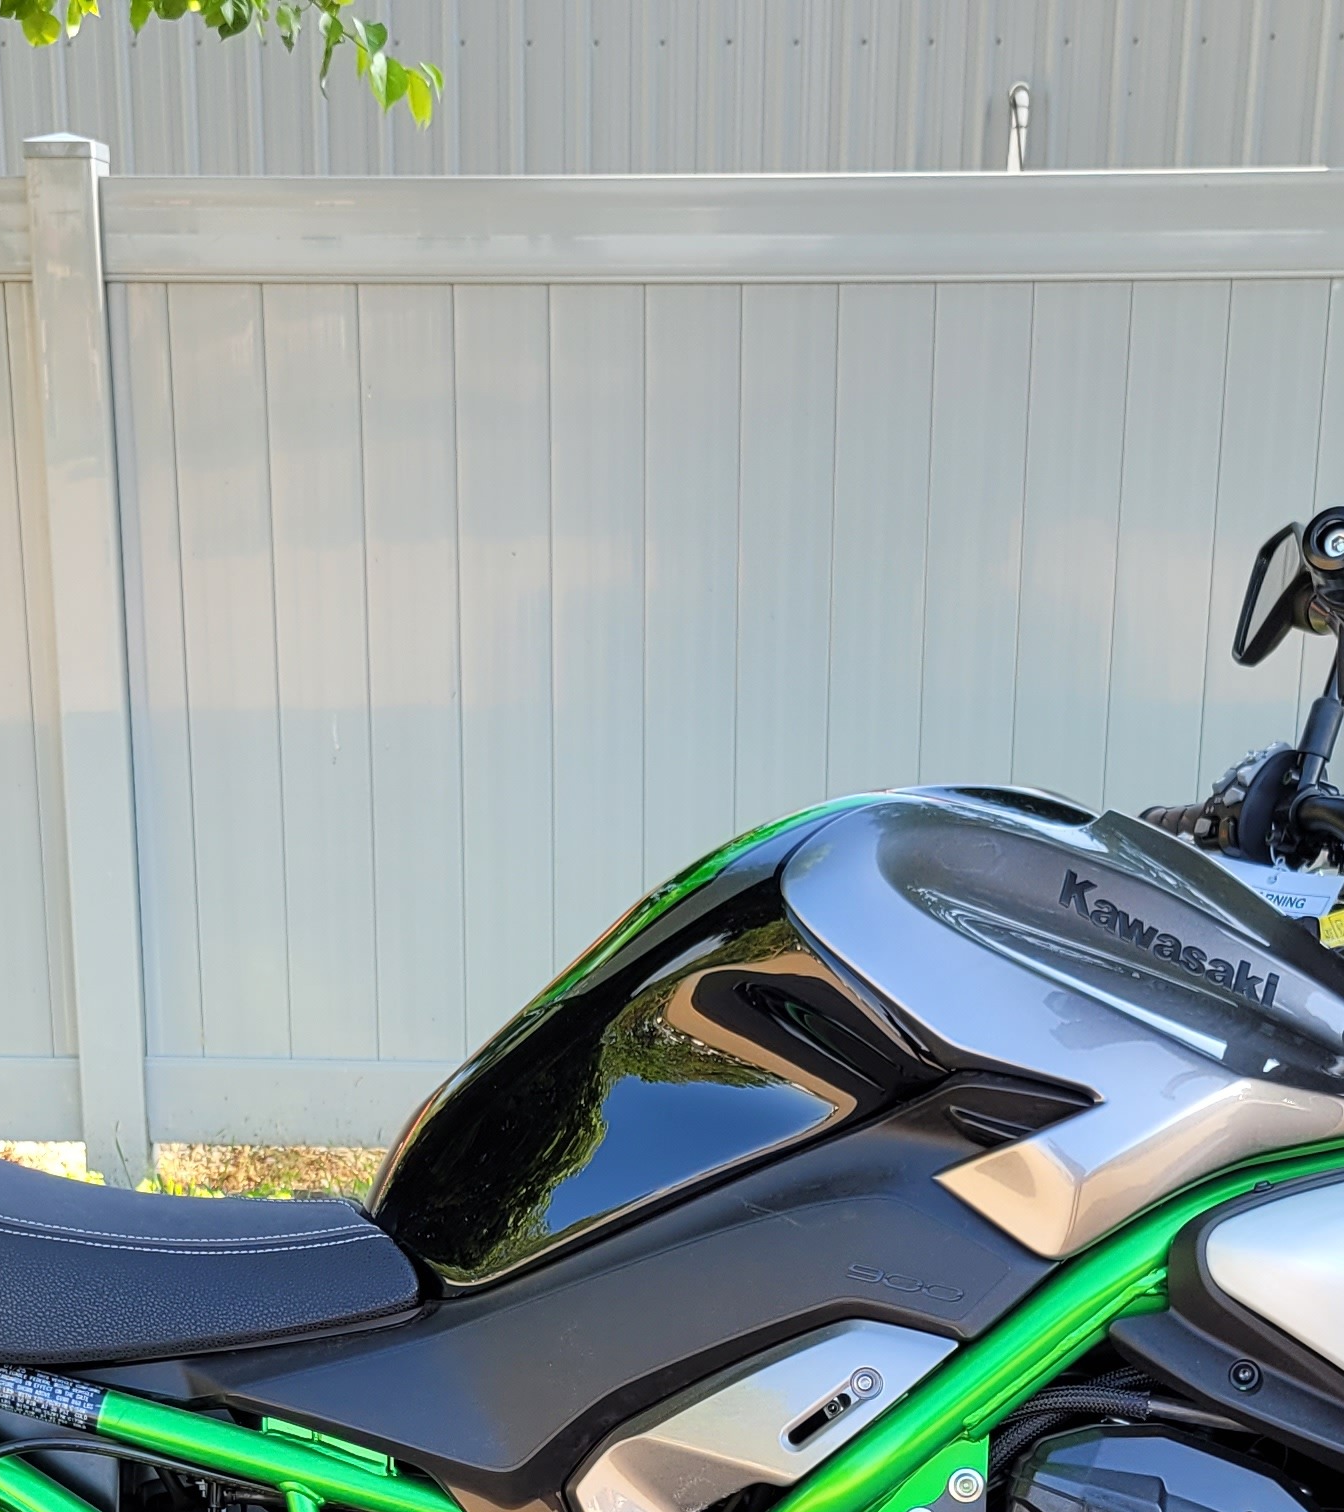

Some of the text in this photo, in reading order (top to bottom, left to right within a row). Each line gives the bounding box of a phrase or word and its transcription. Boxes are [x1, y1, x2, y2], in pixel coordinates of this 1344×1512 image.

[1260, 891, 1306, 909] RNING
[1058, 869, 1280, 1008] Kawasaki
[846, 1263, 964, 1302] 900
